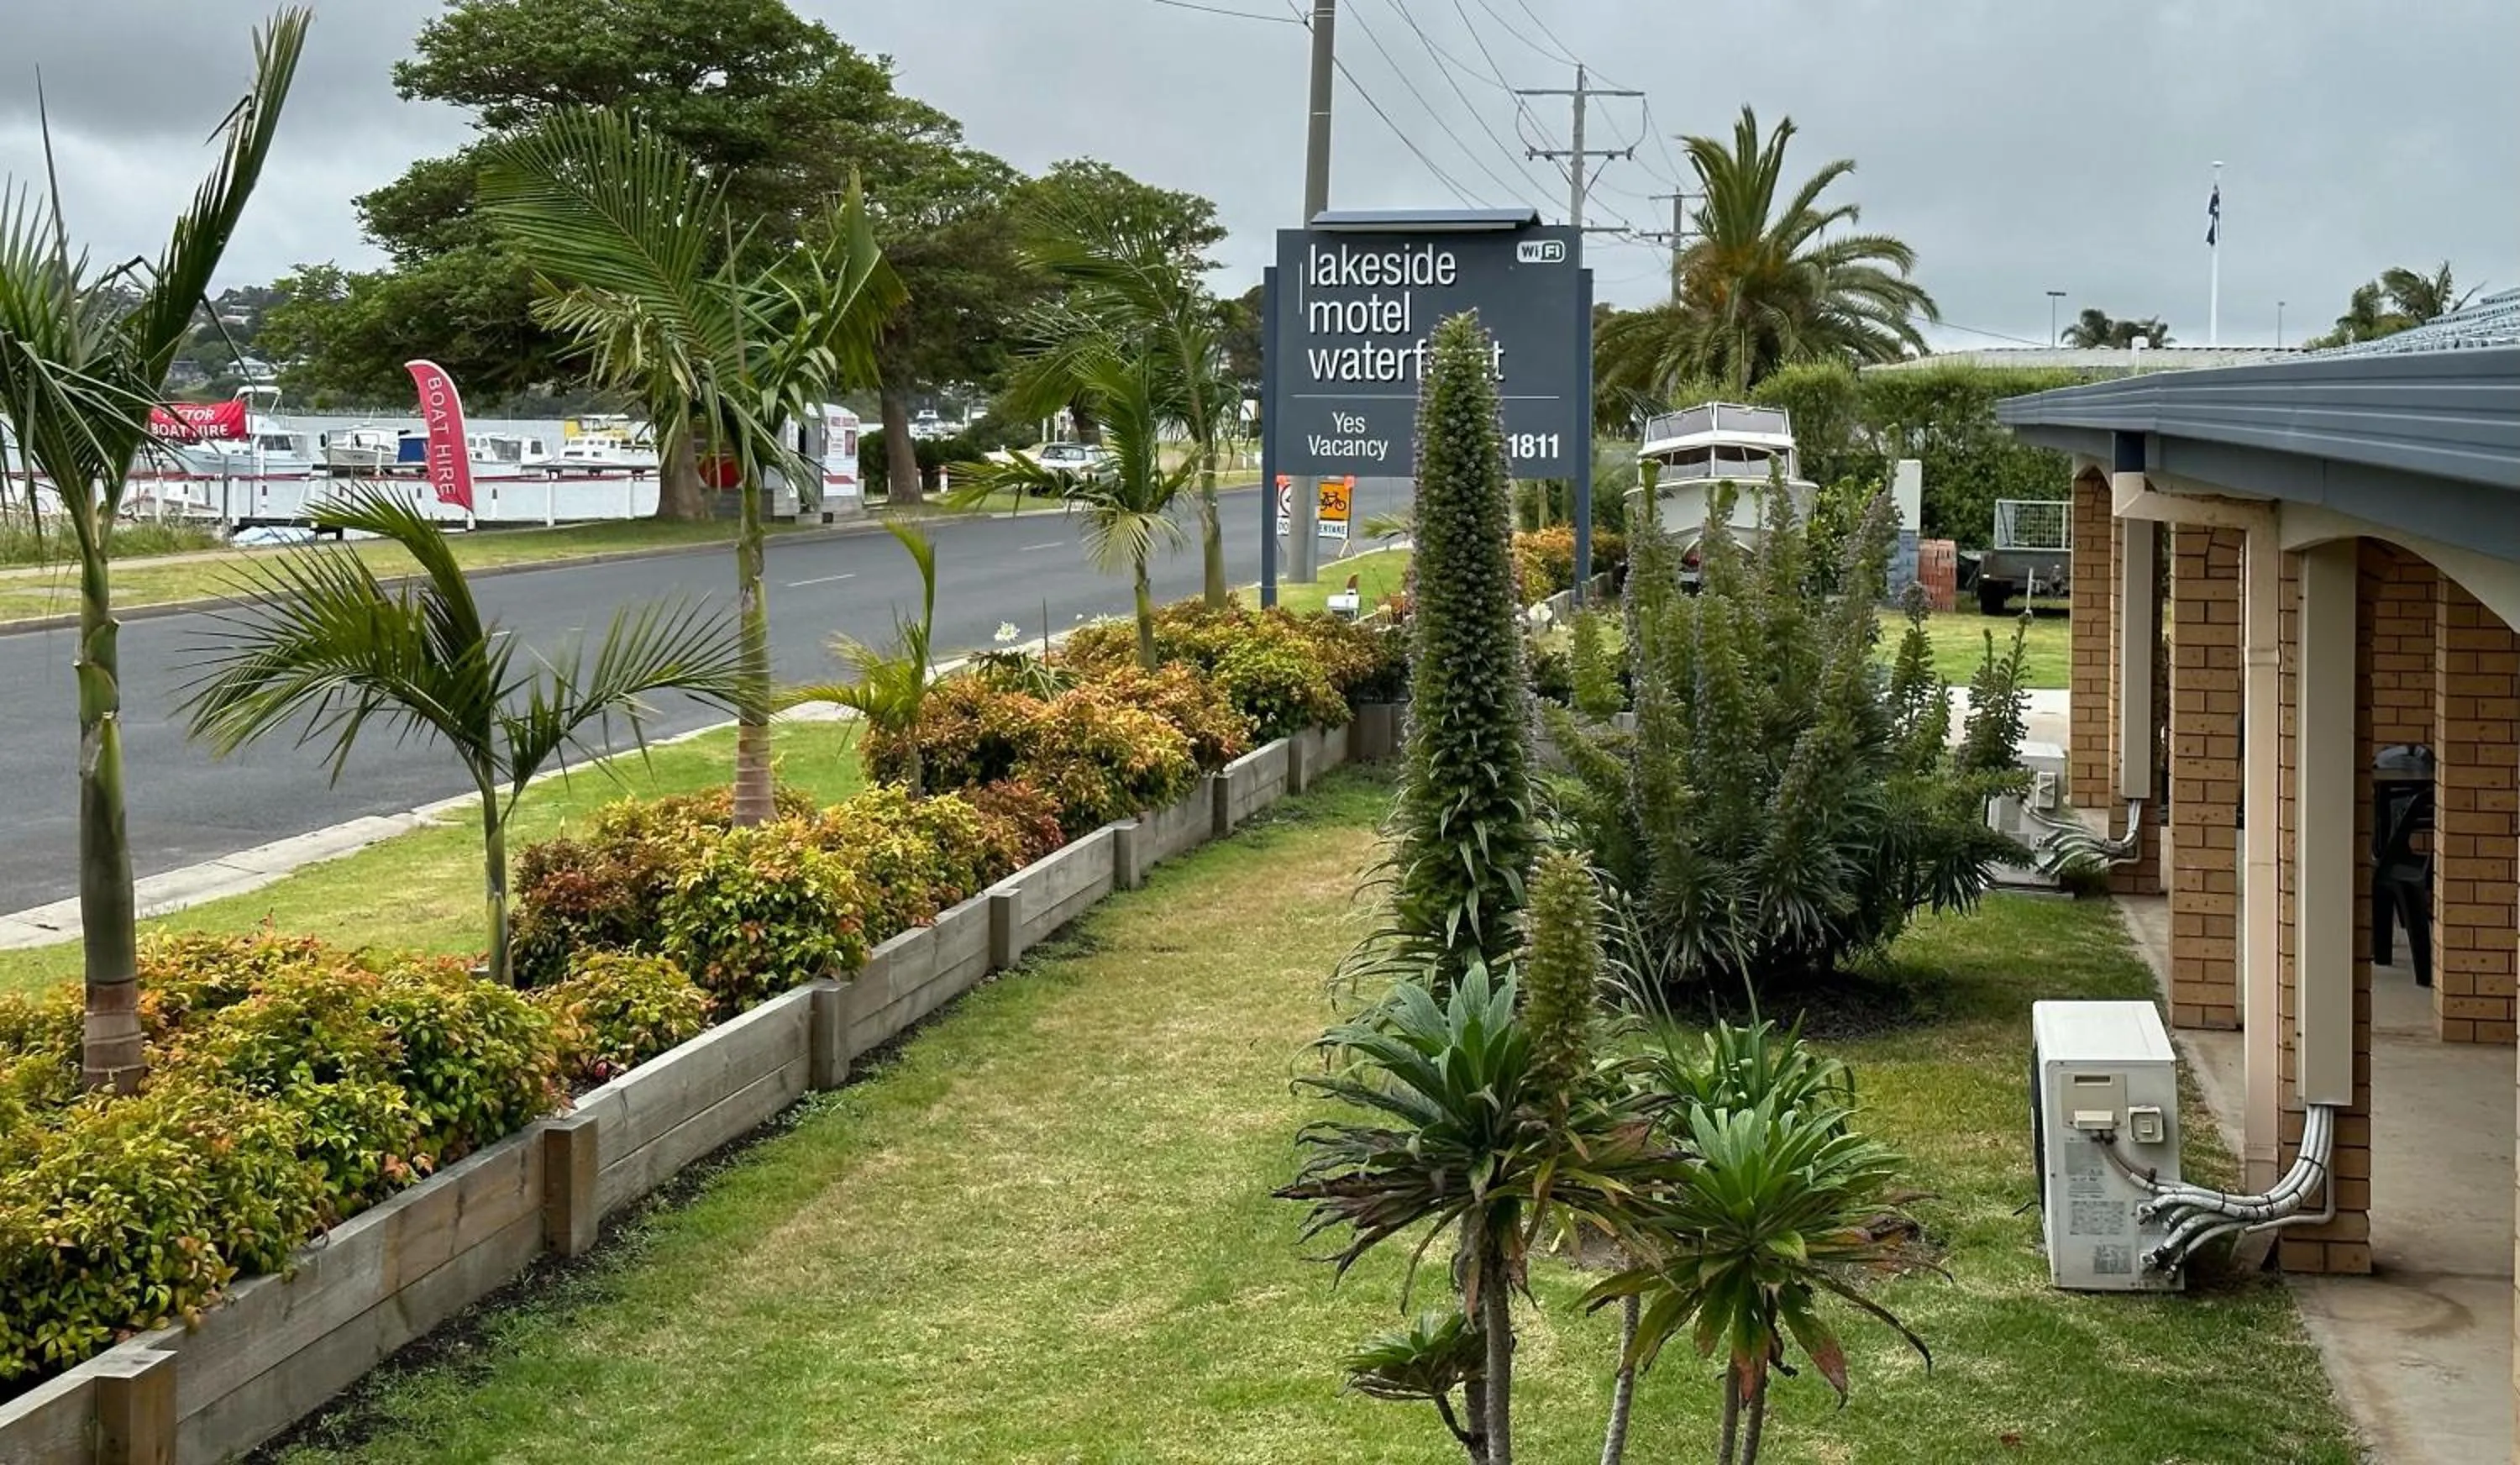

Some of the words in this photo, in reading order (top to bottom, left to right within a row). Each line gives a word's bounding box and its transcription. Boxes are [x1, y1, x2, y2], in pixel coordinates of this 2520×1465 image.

[1310, 244, 1457, 286] lakeside
[1309, 291, 1411, 333] motel
[1308, 339, 1505, 381] waterft
[427, 376, 450, 435] BOAT
[1332, 412, 1366, 434] Yes
[151, 423, 186, 437] BOAT
[1307, 434, 1388, 461] Vacancy
[1508, 433, 1559, 459] 1811
[434, 444, 457, 497] HIRE
